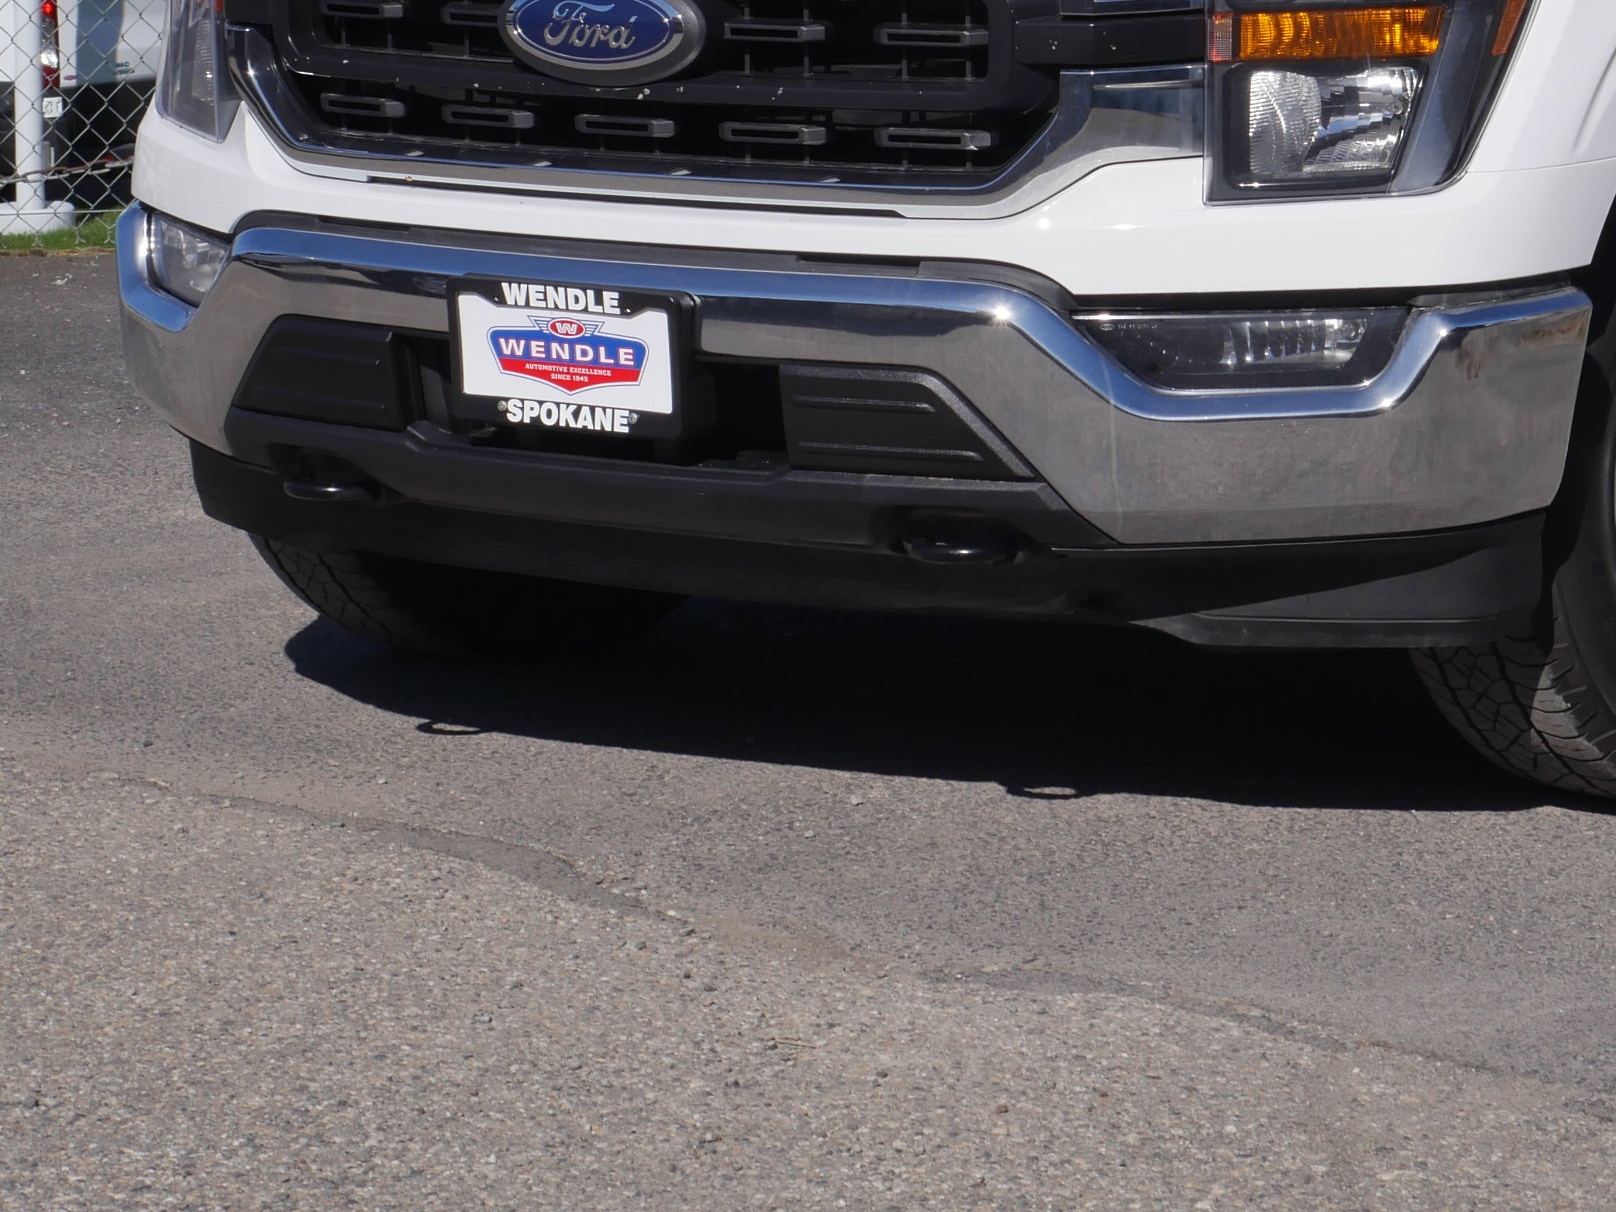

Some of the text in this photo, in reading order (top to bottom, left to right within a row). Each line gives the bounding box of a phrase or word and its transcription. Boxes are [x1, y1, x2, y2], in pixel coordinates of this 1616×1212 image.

[543, 0, 638, 50] Ford
[501, 282, 621, 315] WENDLE
[499, 338, 635, 366] WENDLE
[525, 363, 612, 376] AUTOMOTIVE EXCELLENCE
[550, 373, 571, 381] SINCE
[506, 399, 630, 433] SPOKANE
